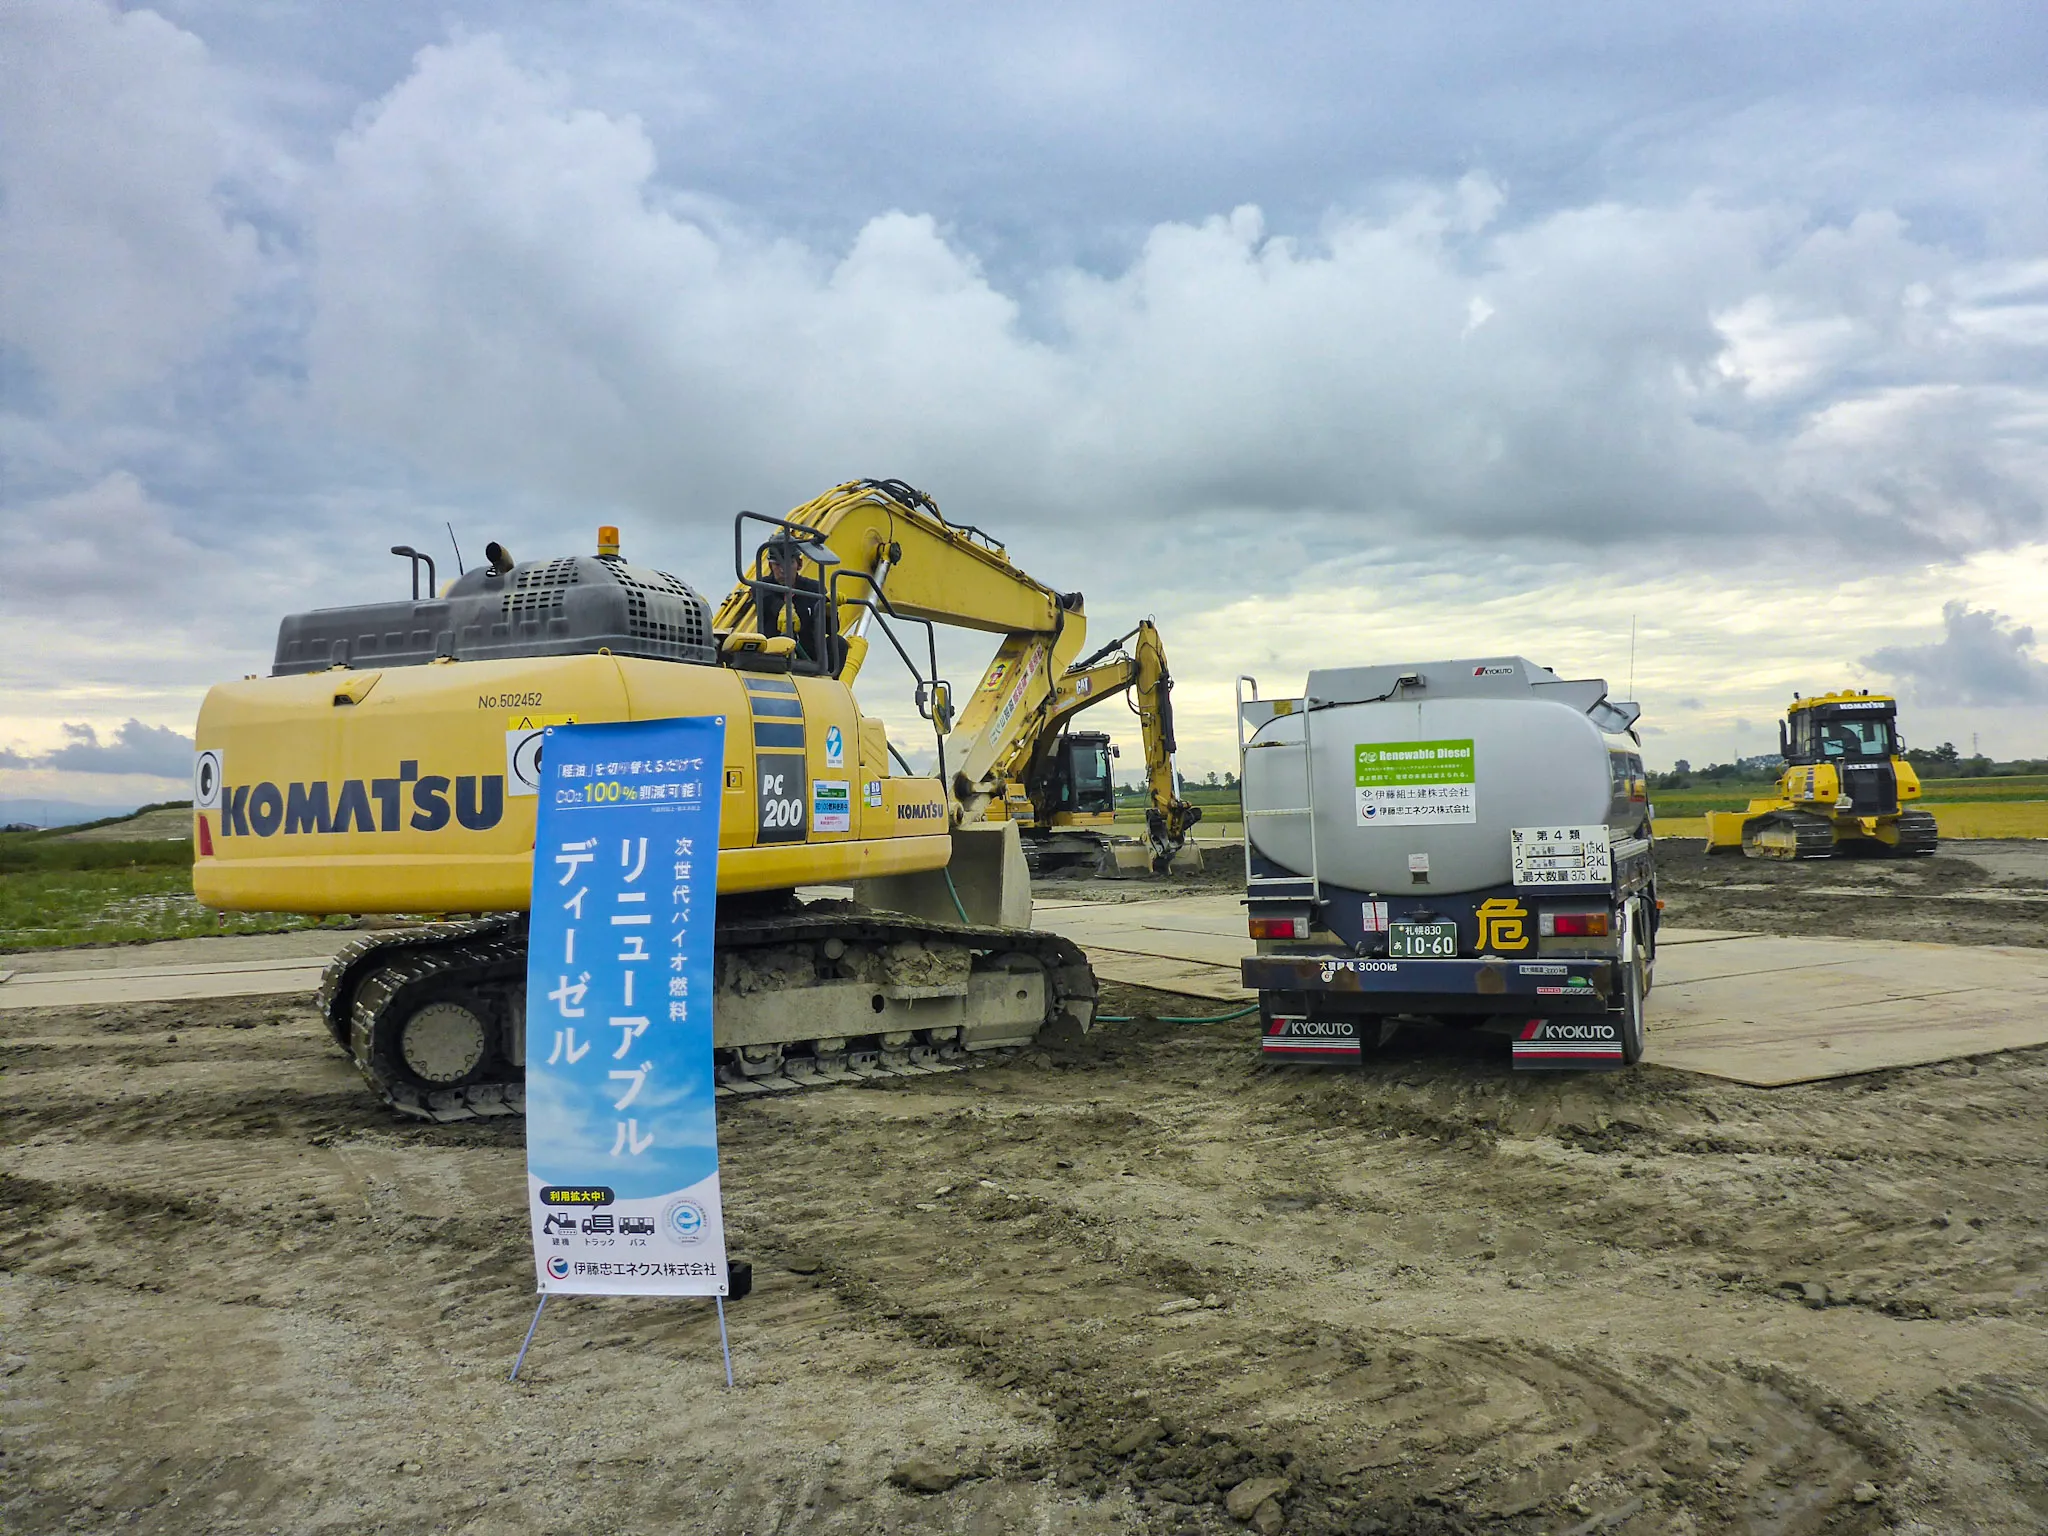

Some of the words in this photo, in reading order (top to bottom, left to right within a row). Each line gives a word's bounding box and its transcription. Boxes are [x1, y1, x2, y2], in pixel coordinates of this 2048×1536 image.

[1076, 677, 1088, 695] CAT
[478, 691, 543, 709] No.502452
[1379, 749, 1435, 761] Renewable
[1437, 747, 1470, 759] Diesel
[763, 774, 784, 796] PC
[1375, 787, 1470, 800] 伊藤組土建株式会社
[221, 759, 504, 837] KOMATSU
[763, 799, 803, 828] 200
[897, 800, 944, 820] KOMATSU
[1379, 804, 1470, 816] 伊藤忠エネクス株式会社
[1515, 846, 1520, 856] 1
[1515, 858, 1523, 869] 2
[1523, 870, 1568, 882] 最大数量
[669, 837, 694, 1022] 次世代バイオ燃料
[1474, 897, 1529, 951] 危
[546, 837, 598, 1065] ディーゼル
[1393, 941, 1402, 950] あ
[1405, 936, 1454, 955] 10-60
[608, 837, 655, 1157] リニューアブル
[1291, 1022, 1354, 1036] KYOKUTO
[1545, 1025, 1615, 1039] KYOKUTO
[550, 1190, 605, 1202] 利用拡大中!
[574, 1261, 717, 1276] 伊藤忠エネクス株式会社
